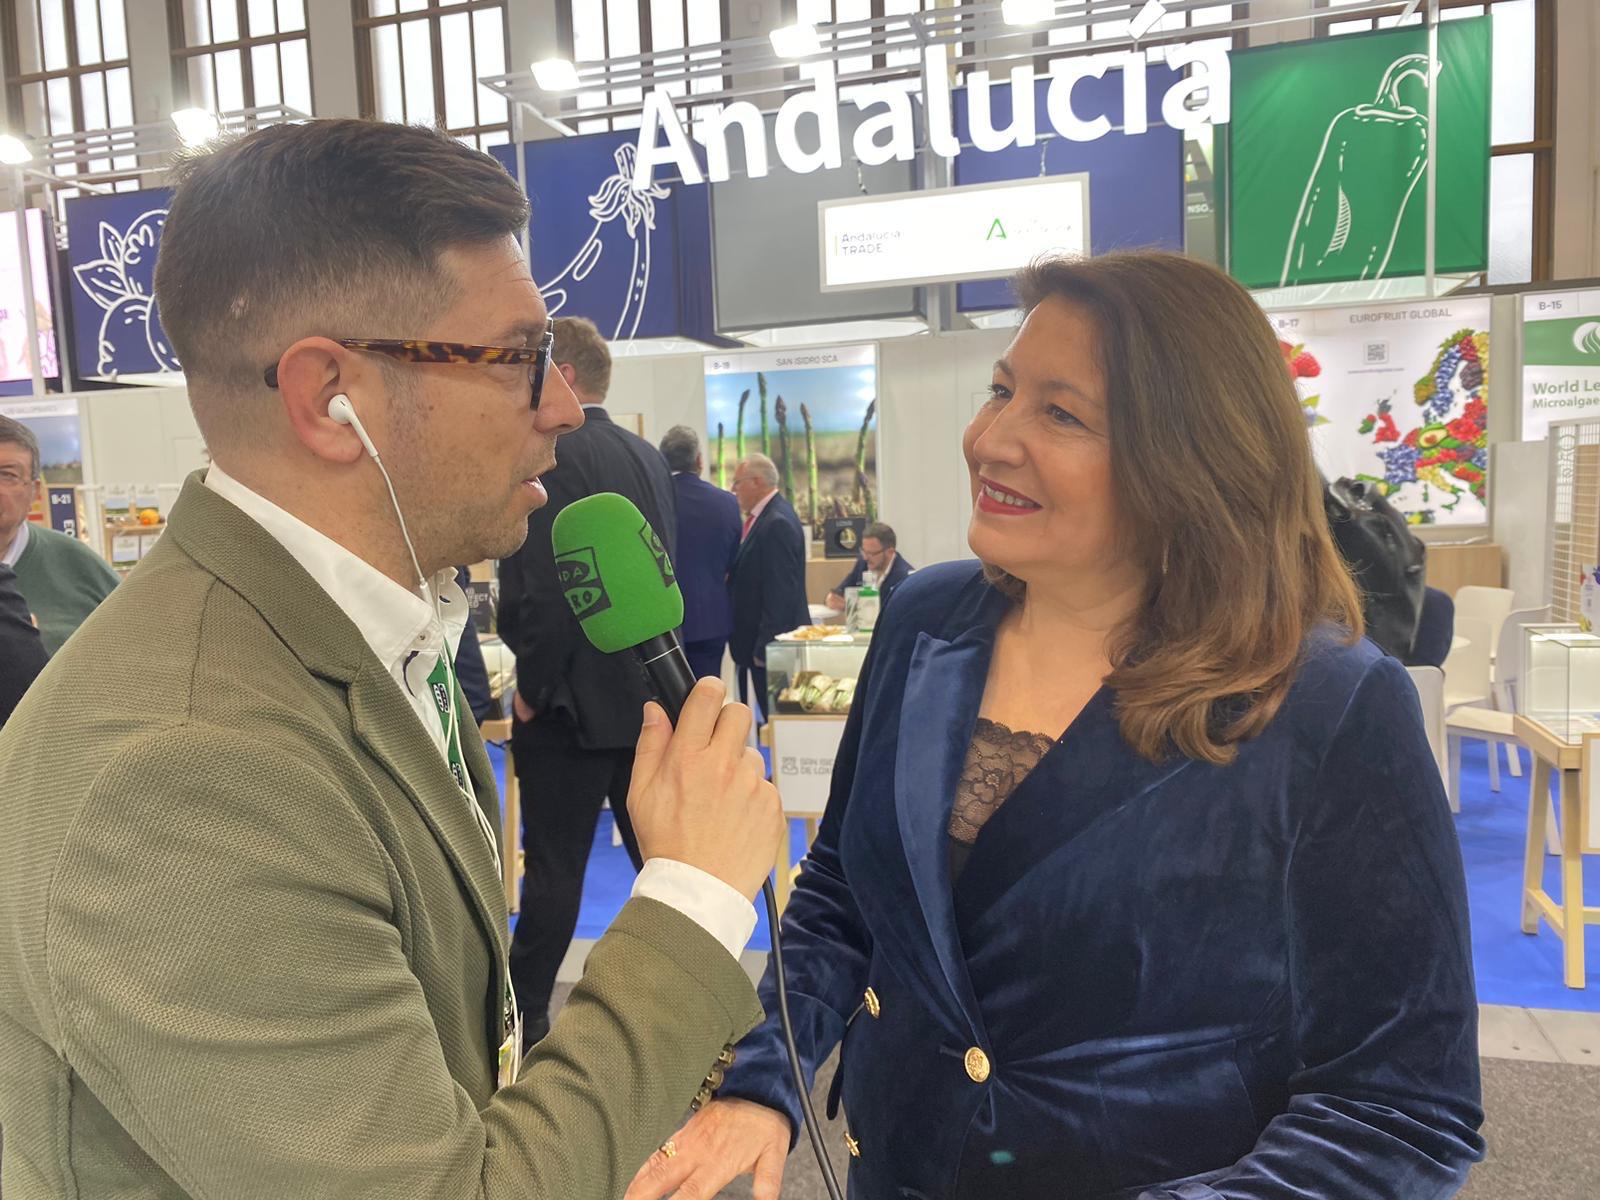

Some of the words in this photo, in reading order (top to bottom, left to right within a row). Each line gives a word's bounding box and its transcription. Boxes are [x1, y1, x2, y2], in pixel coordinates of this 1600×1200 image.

[632, 0, 1232, 191] Andalucía
[841, 243, 883, 256] TRADE
[1538, 301, 1562, 311] B-15
[1350, 310, 1408, 324] EUROFRUIT
[1410, 308, 1452, 319] GLOBAL
[1532, 380, 1580, 396] World
